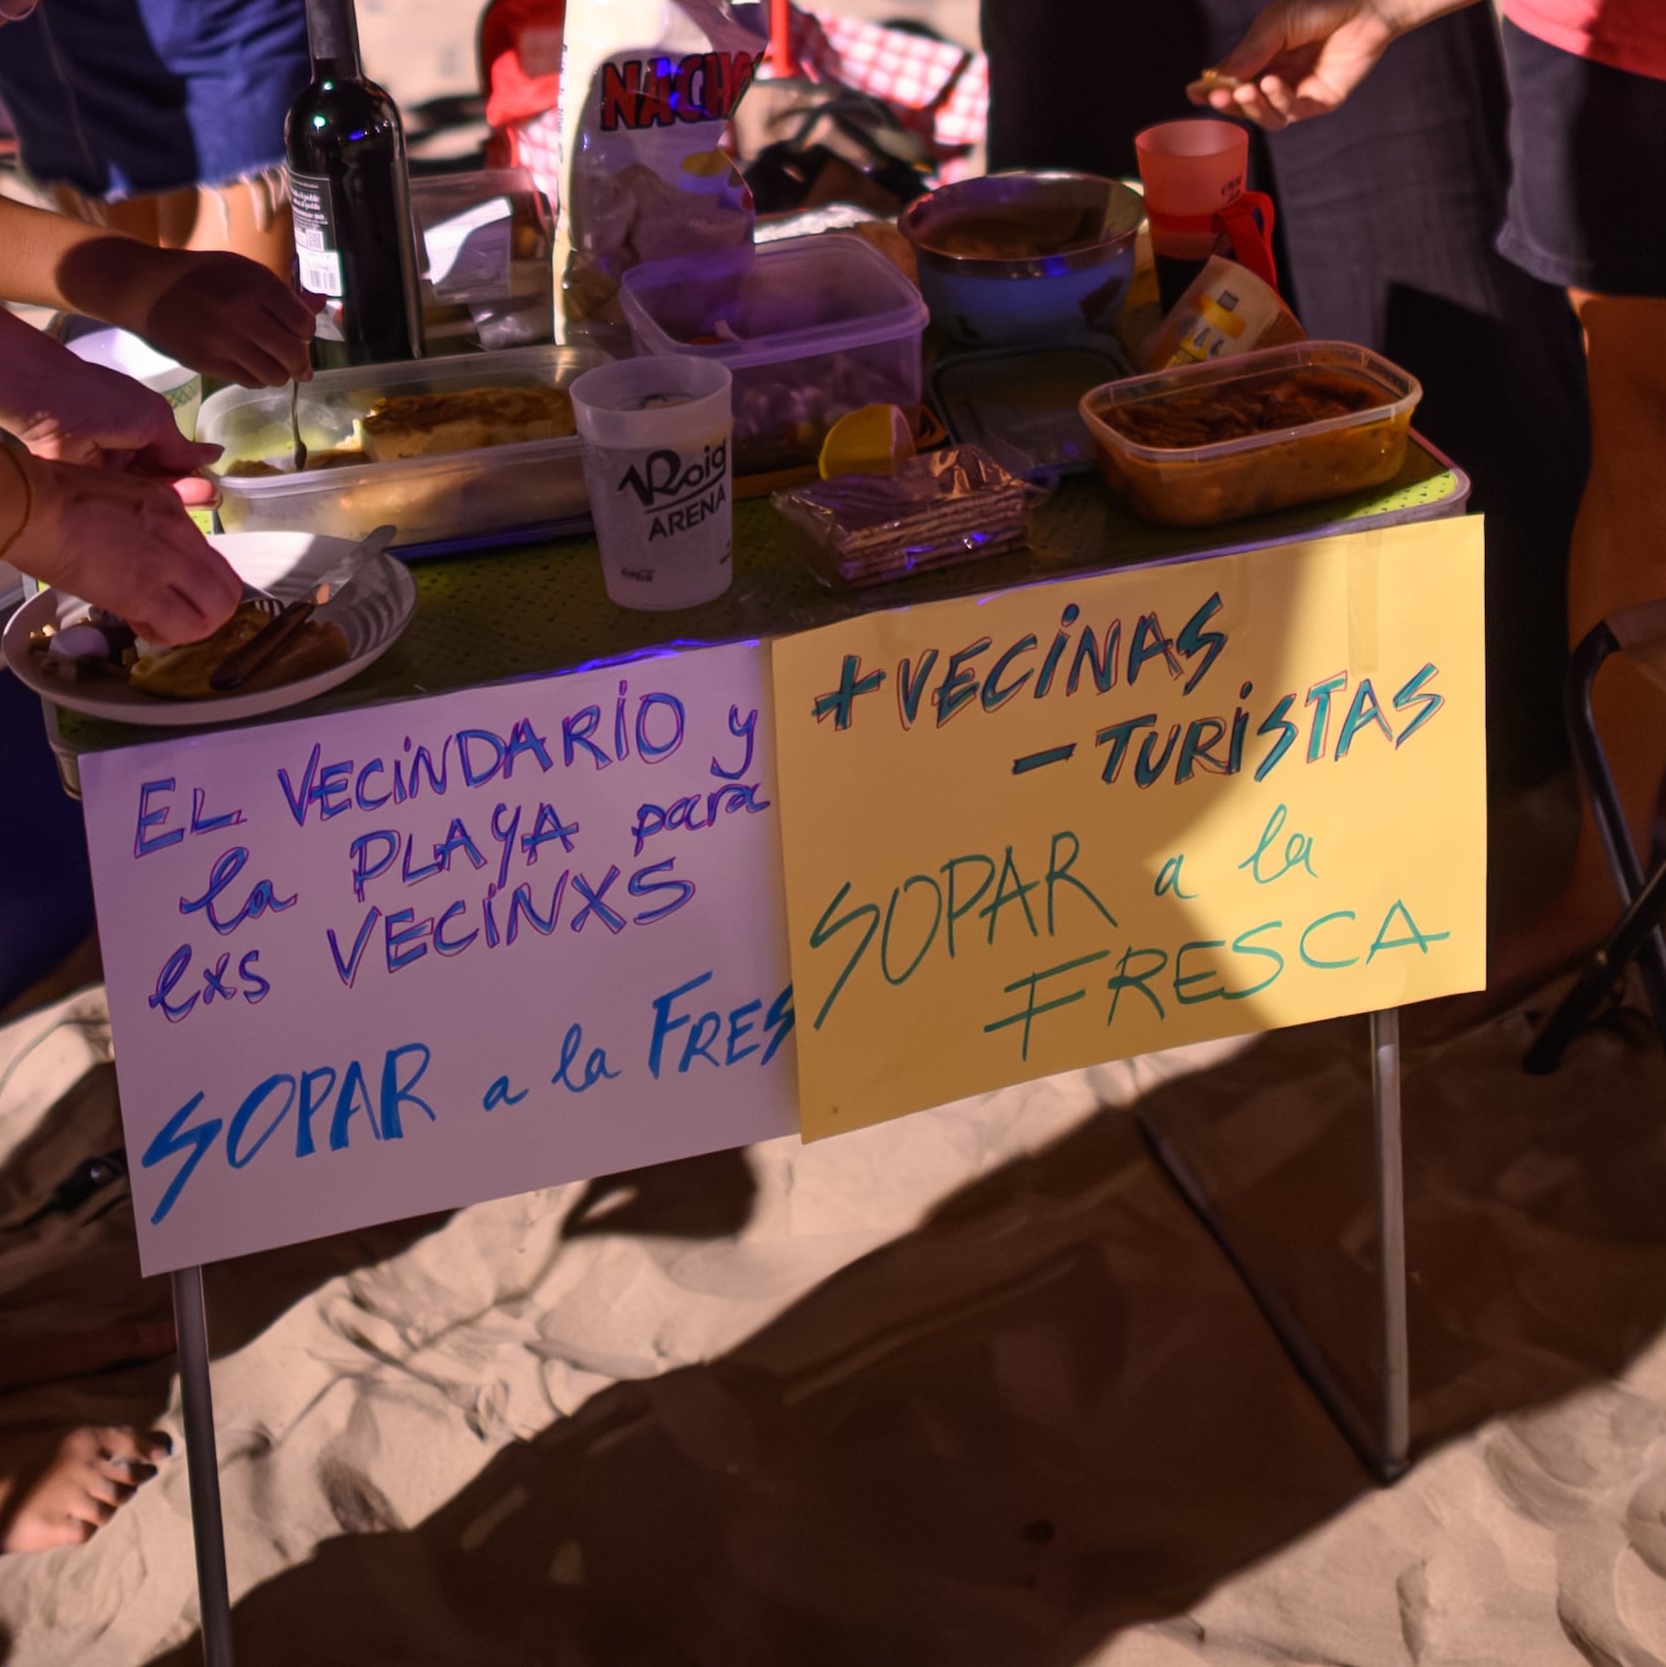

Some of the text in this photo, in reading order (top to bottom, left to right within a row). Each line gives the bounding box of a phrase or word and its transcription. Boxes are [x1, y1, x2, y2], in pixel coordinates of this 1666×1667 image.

[600, 51, 764, 131] NACHO
[617, 438, 726, 507] Roig
[648, 484, 726, 542] ARENA
[135, 778, 247, 859] EL
[712, 705, 758, 780] y
[180, 783, 771, 935] la PLAYA para
[810, 804, 1319, 1031] SOPAR a la
[149, 944, 271, 1022] lxs
[983, 899, 1450, 1062] FRESCA
[141, 970, 797, 1225] SOPAR a la FRES
